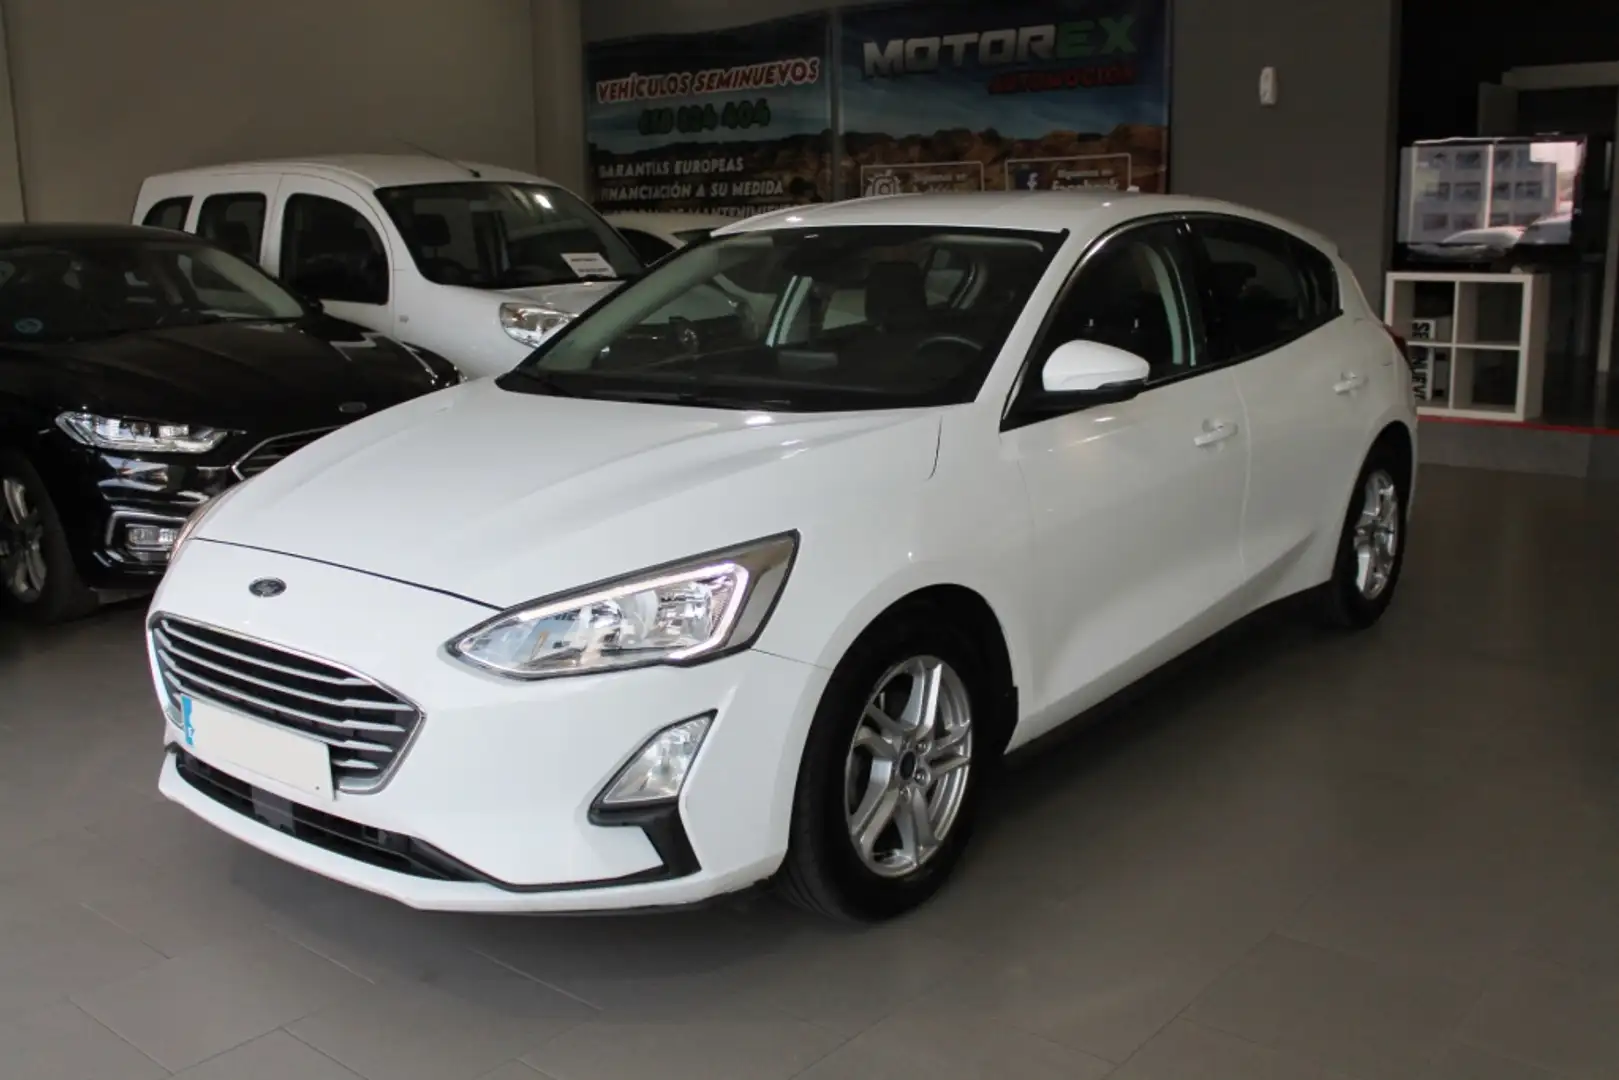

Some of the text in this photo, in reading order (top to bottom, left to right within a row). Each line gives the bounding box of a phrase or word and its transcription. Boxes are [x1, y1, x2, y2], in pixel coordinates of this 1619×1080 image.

[863, 14, 1137, 77] MOTOREX
[597, 56, 819, 103] VEHÍCULOS SEMINUEVOS
[674, 157, 744, 175] EUROPEAS
[695, 187, 705, 198] A
[710, 183, 727, 197] SU
[732, 180, 784, 196] MEDIDA
